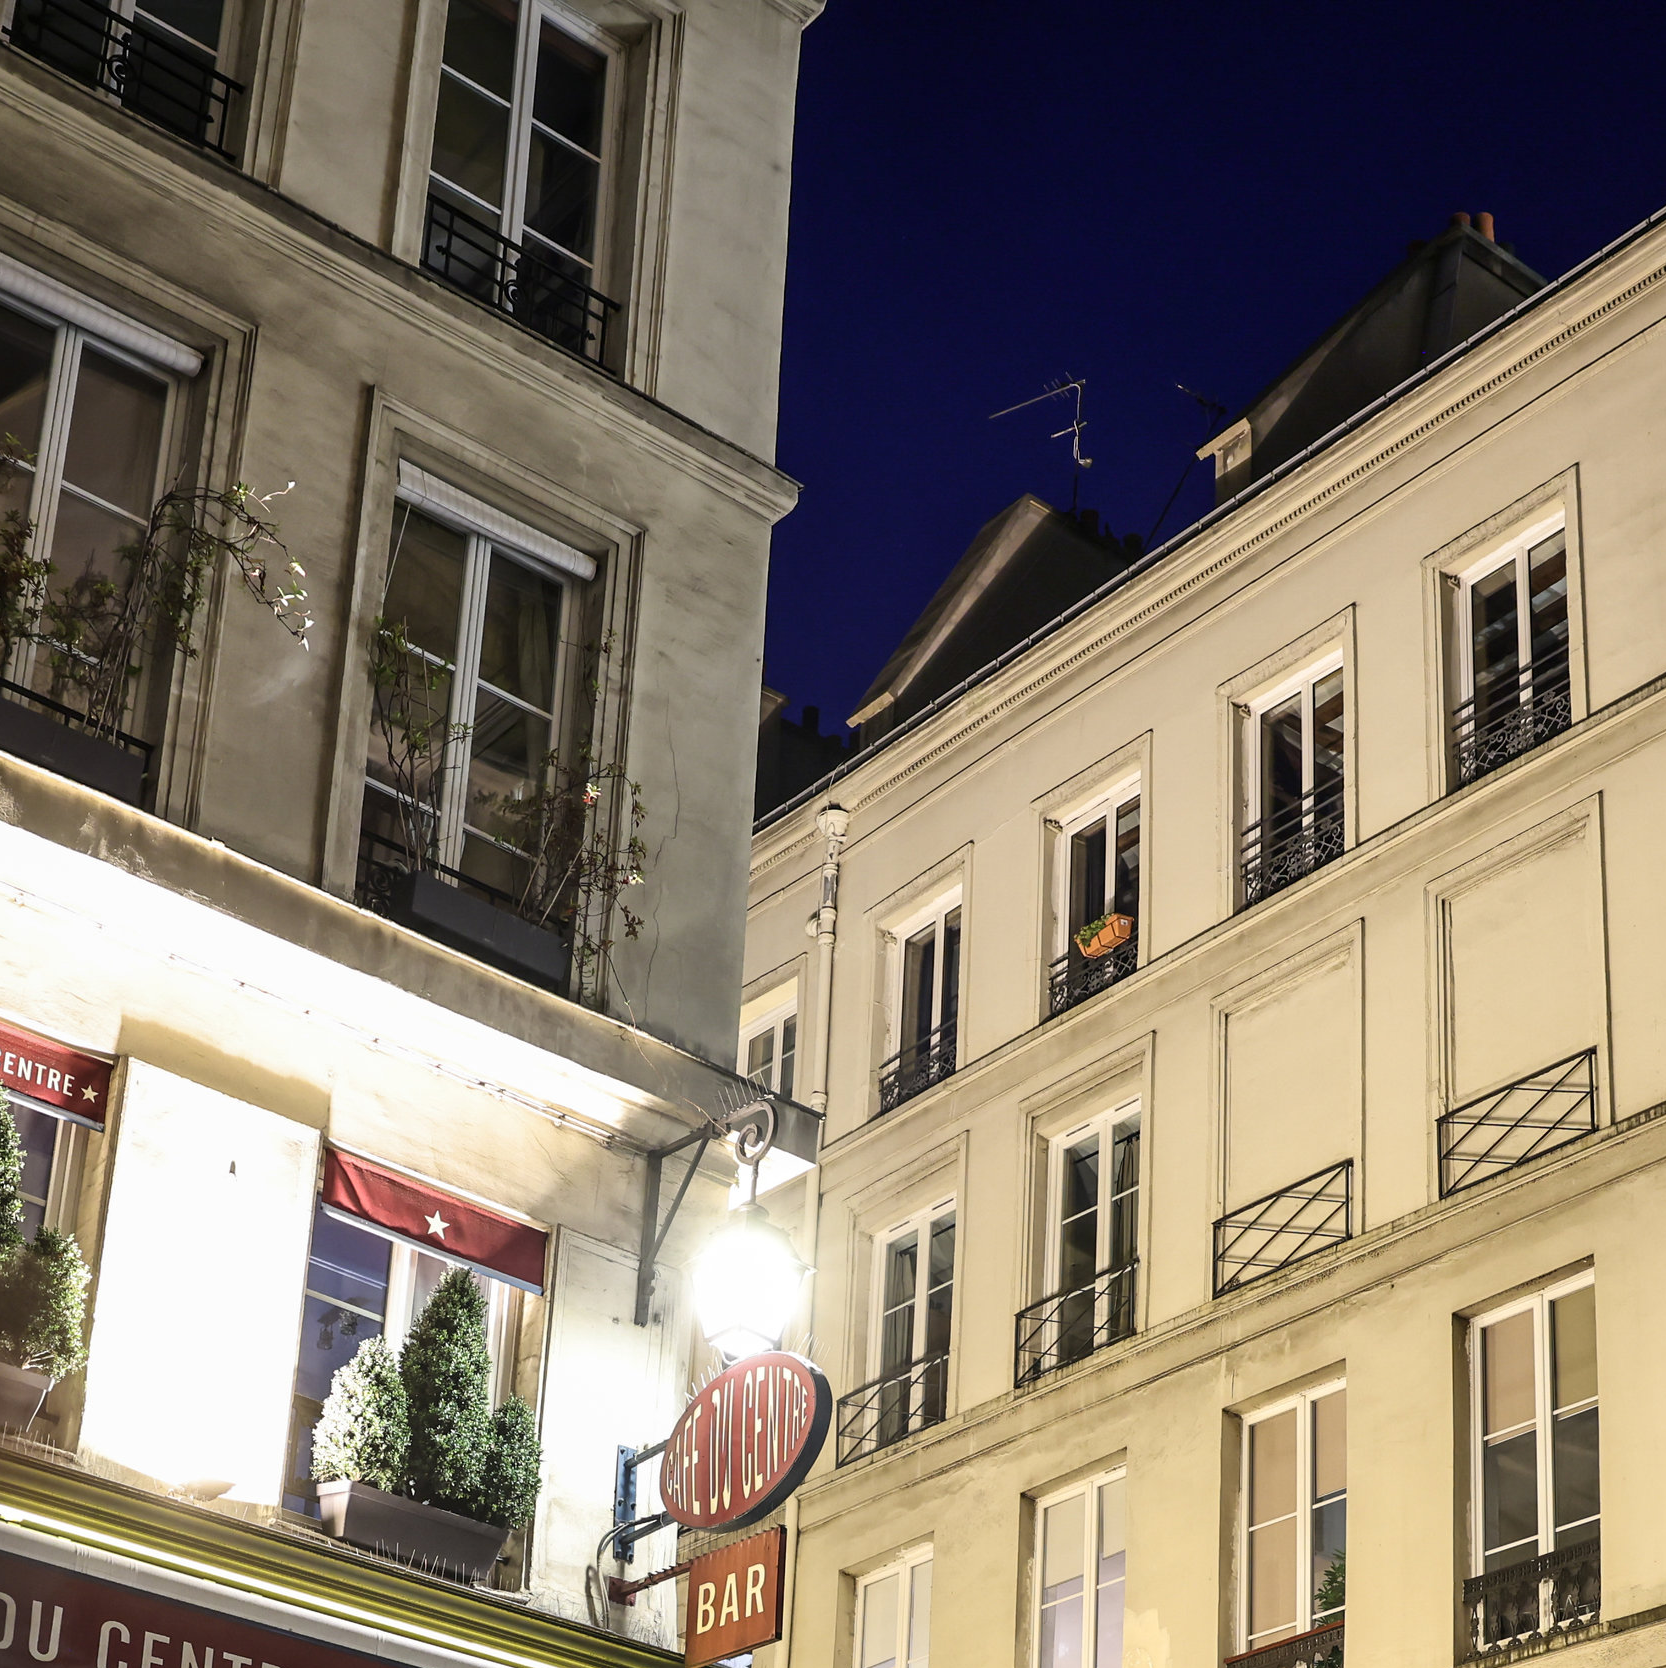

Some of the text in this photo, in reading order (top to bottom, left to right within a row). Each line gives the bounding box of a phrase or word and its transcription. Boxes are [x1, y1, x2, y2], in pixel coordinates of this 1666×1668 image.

[665, 1365, 809, 1516] CAFE DU CENTRE
[695, 1562, 767, 1636] BAR
